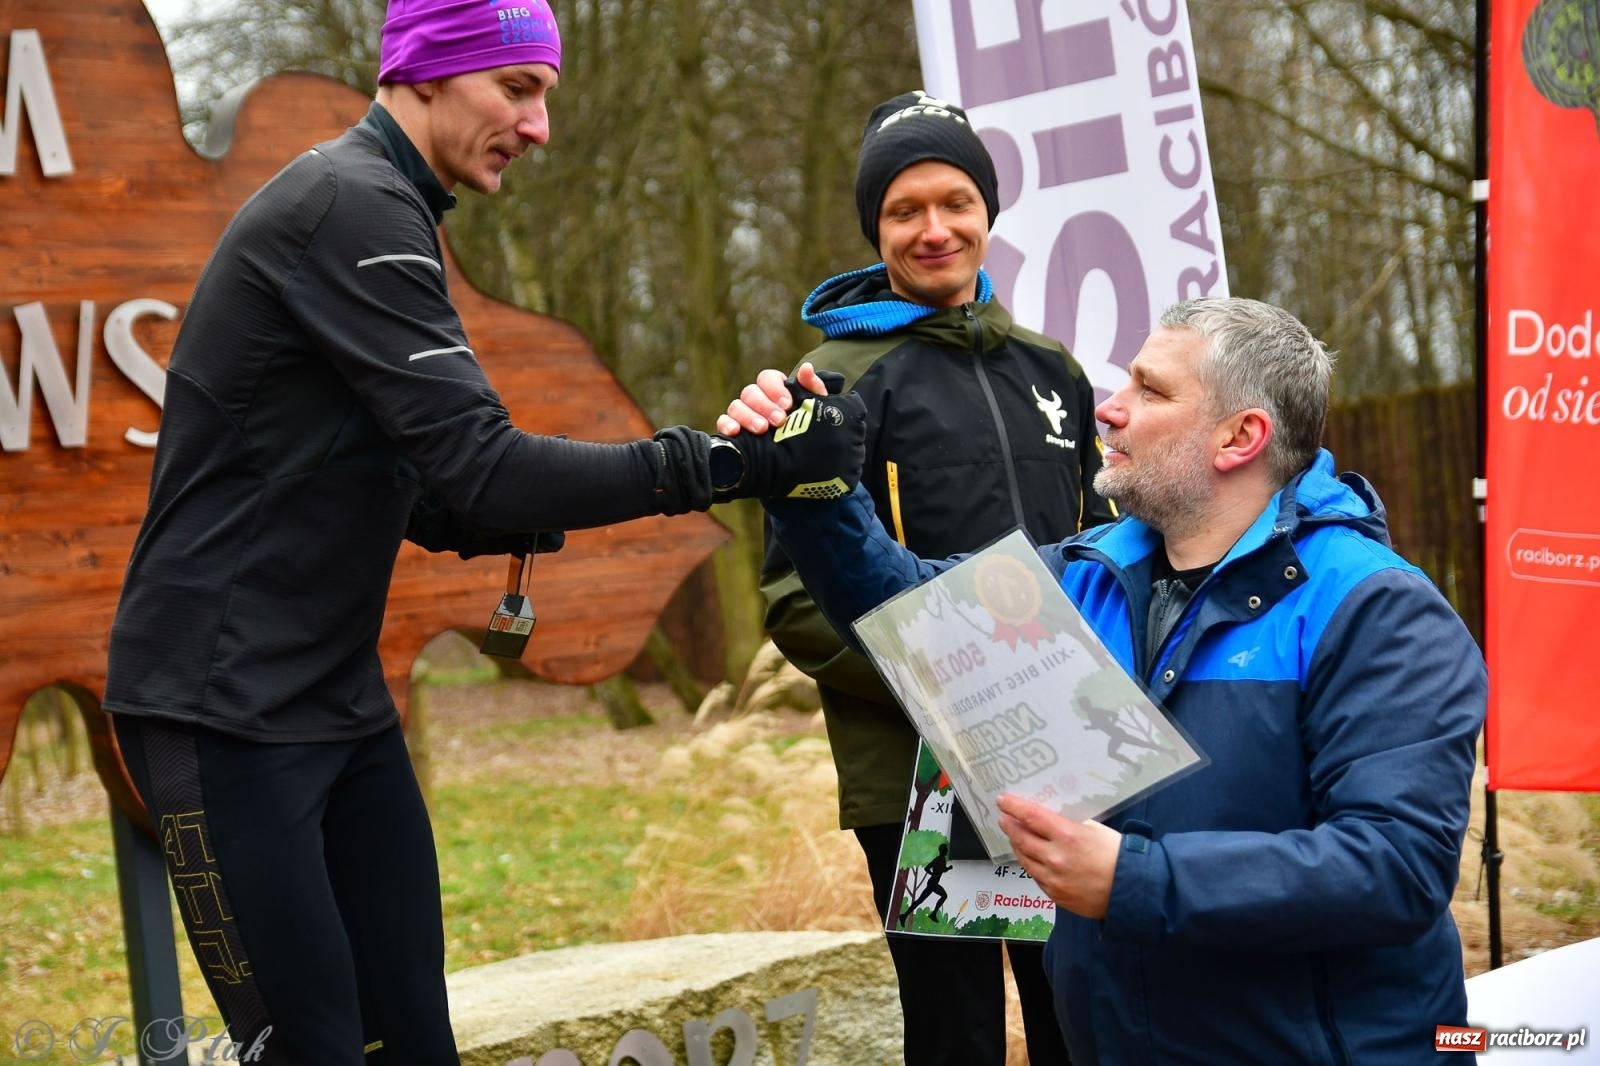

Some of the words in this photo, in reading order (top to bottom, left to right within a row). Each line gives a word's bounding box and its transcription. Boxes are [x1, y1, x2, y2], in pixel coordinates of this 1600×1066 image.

[497, 7, 531, 20] BIEG
[1502, 372, 1552, 421] od
[994, 865, 1010, 878] 4F
[994, 893, 1055, 910] Racibórz
